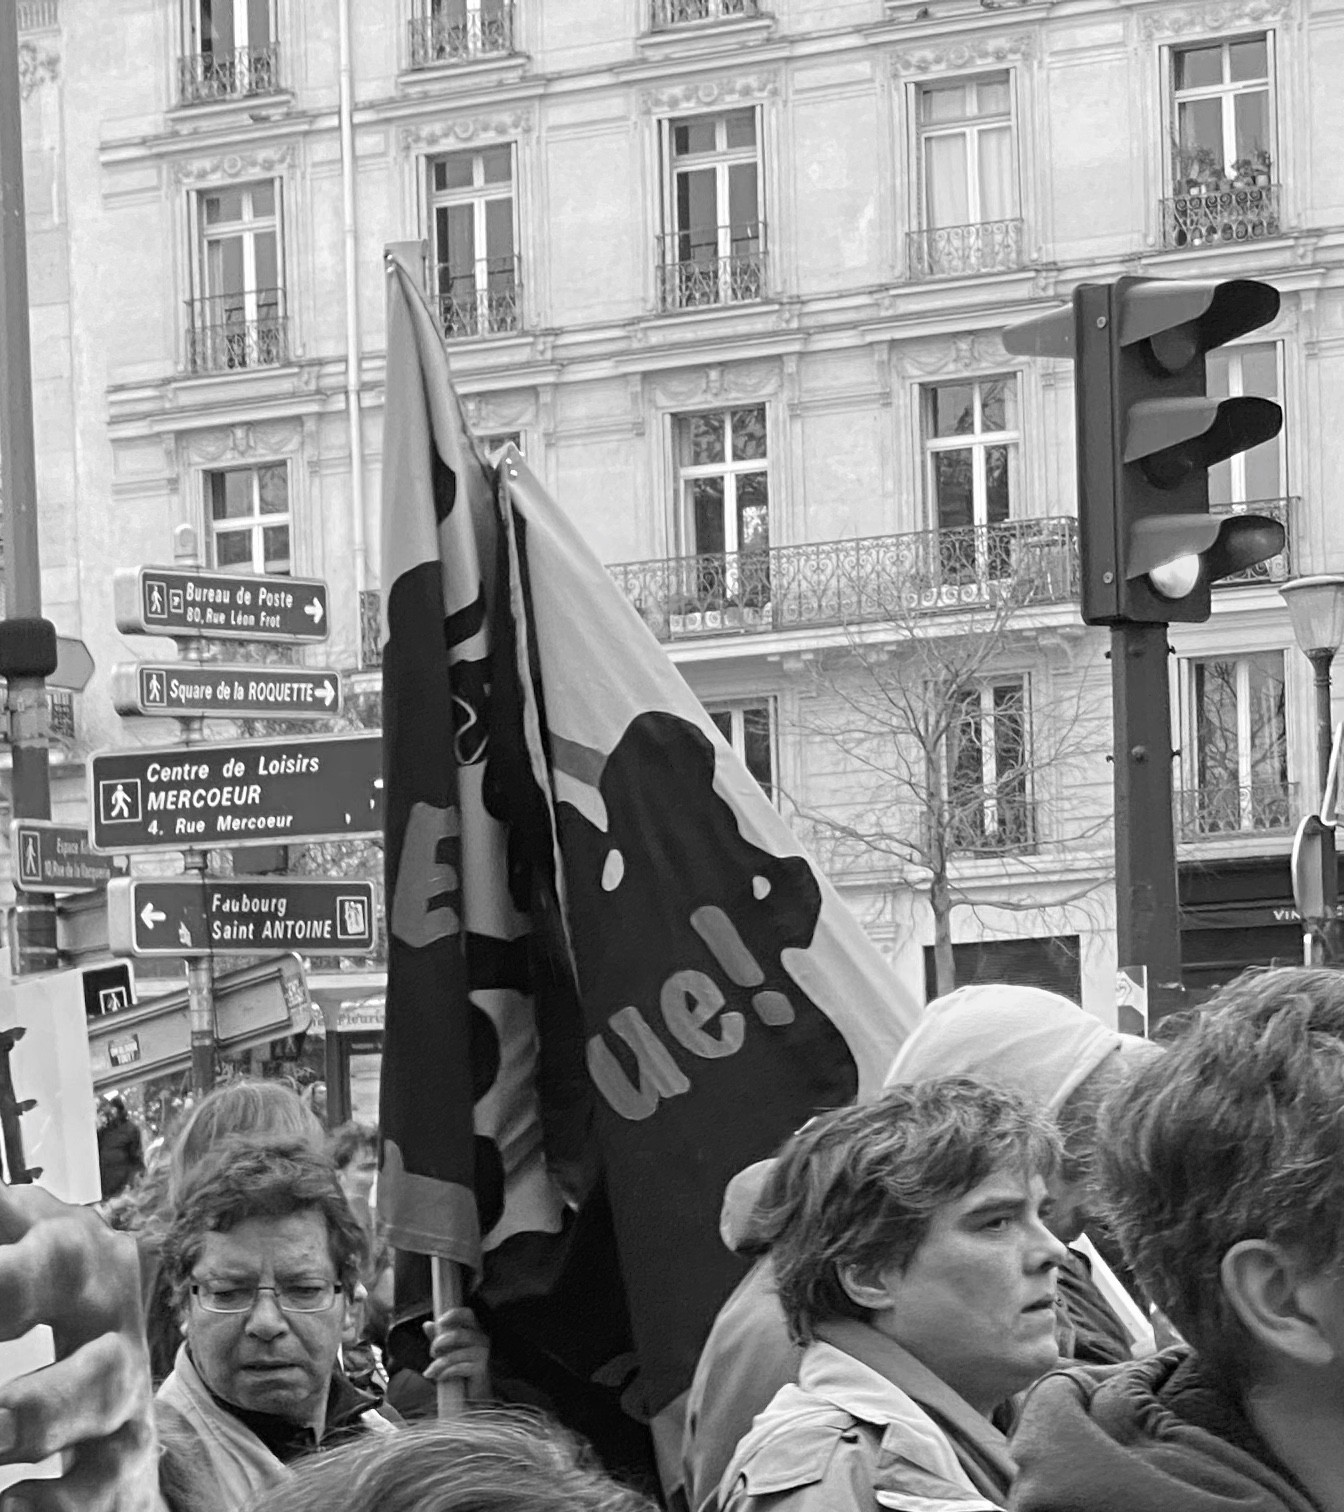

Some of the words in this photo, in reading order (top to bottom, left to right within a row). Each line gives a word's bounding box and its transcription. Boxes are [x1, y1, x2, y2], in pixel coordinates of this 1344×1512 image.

[186, 582, 231, 605] Bureau
[236, 586, 252, 606] de
[258, 587, 294, 609] Poste
[230, 610, 255, 626] Léon
[260, 611, 281, 628] Frot
[169, 679, 213, 703] Square
[216, 681, 231, 699] de
[233, 681, 245, 700] la
[248, 682, 314, 701] ROQUETTE
[147, 763, 210, 783] Centre
[222, 758, 246, 778] de
[258, 754, 320, 776] Loisirs
[147, 784, 262, 811] MERCOEUR
[175, 818, 206, 834] Rue
[216, 814, 294, 832] Mercoeur
[212, 893, 288, 917] Faubourg
[212, 920, 255, 940] Saint
[261, 920, 333, 939] ANTOINE
